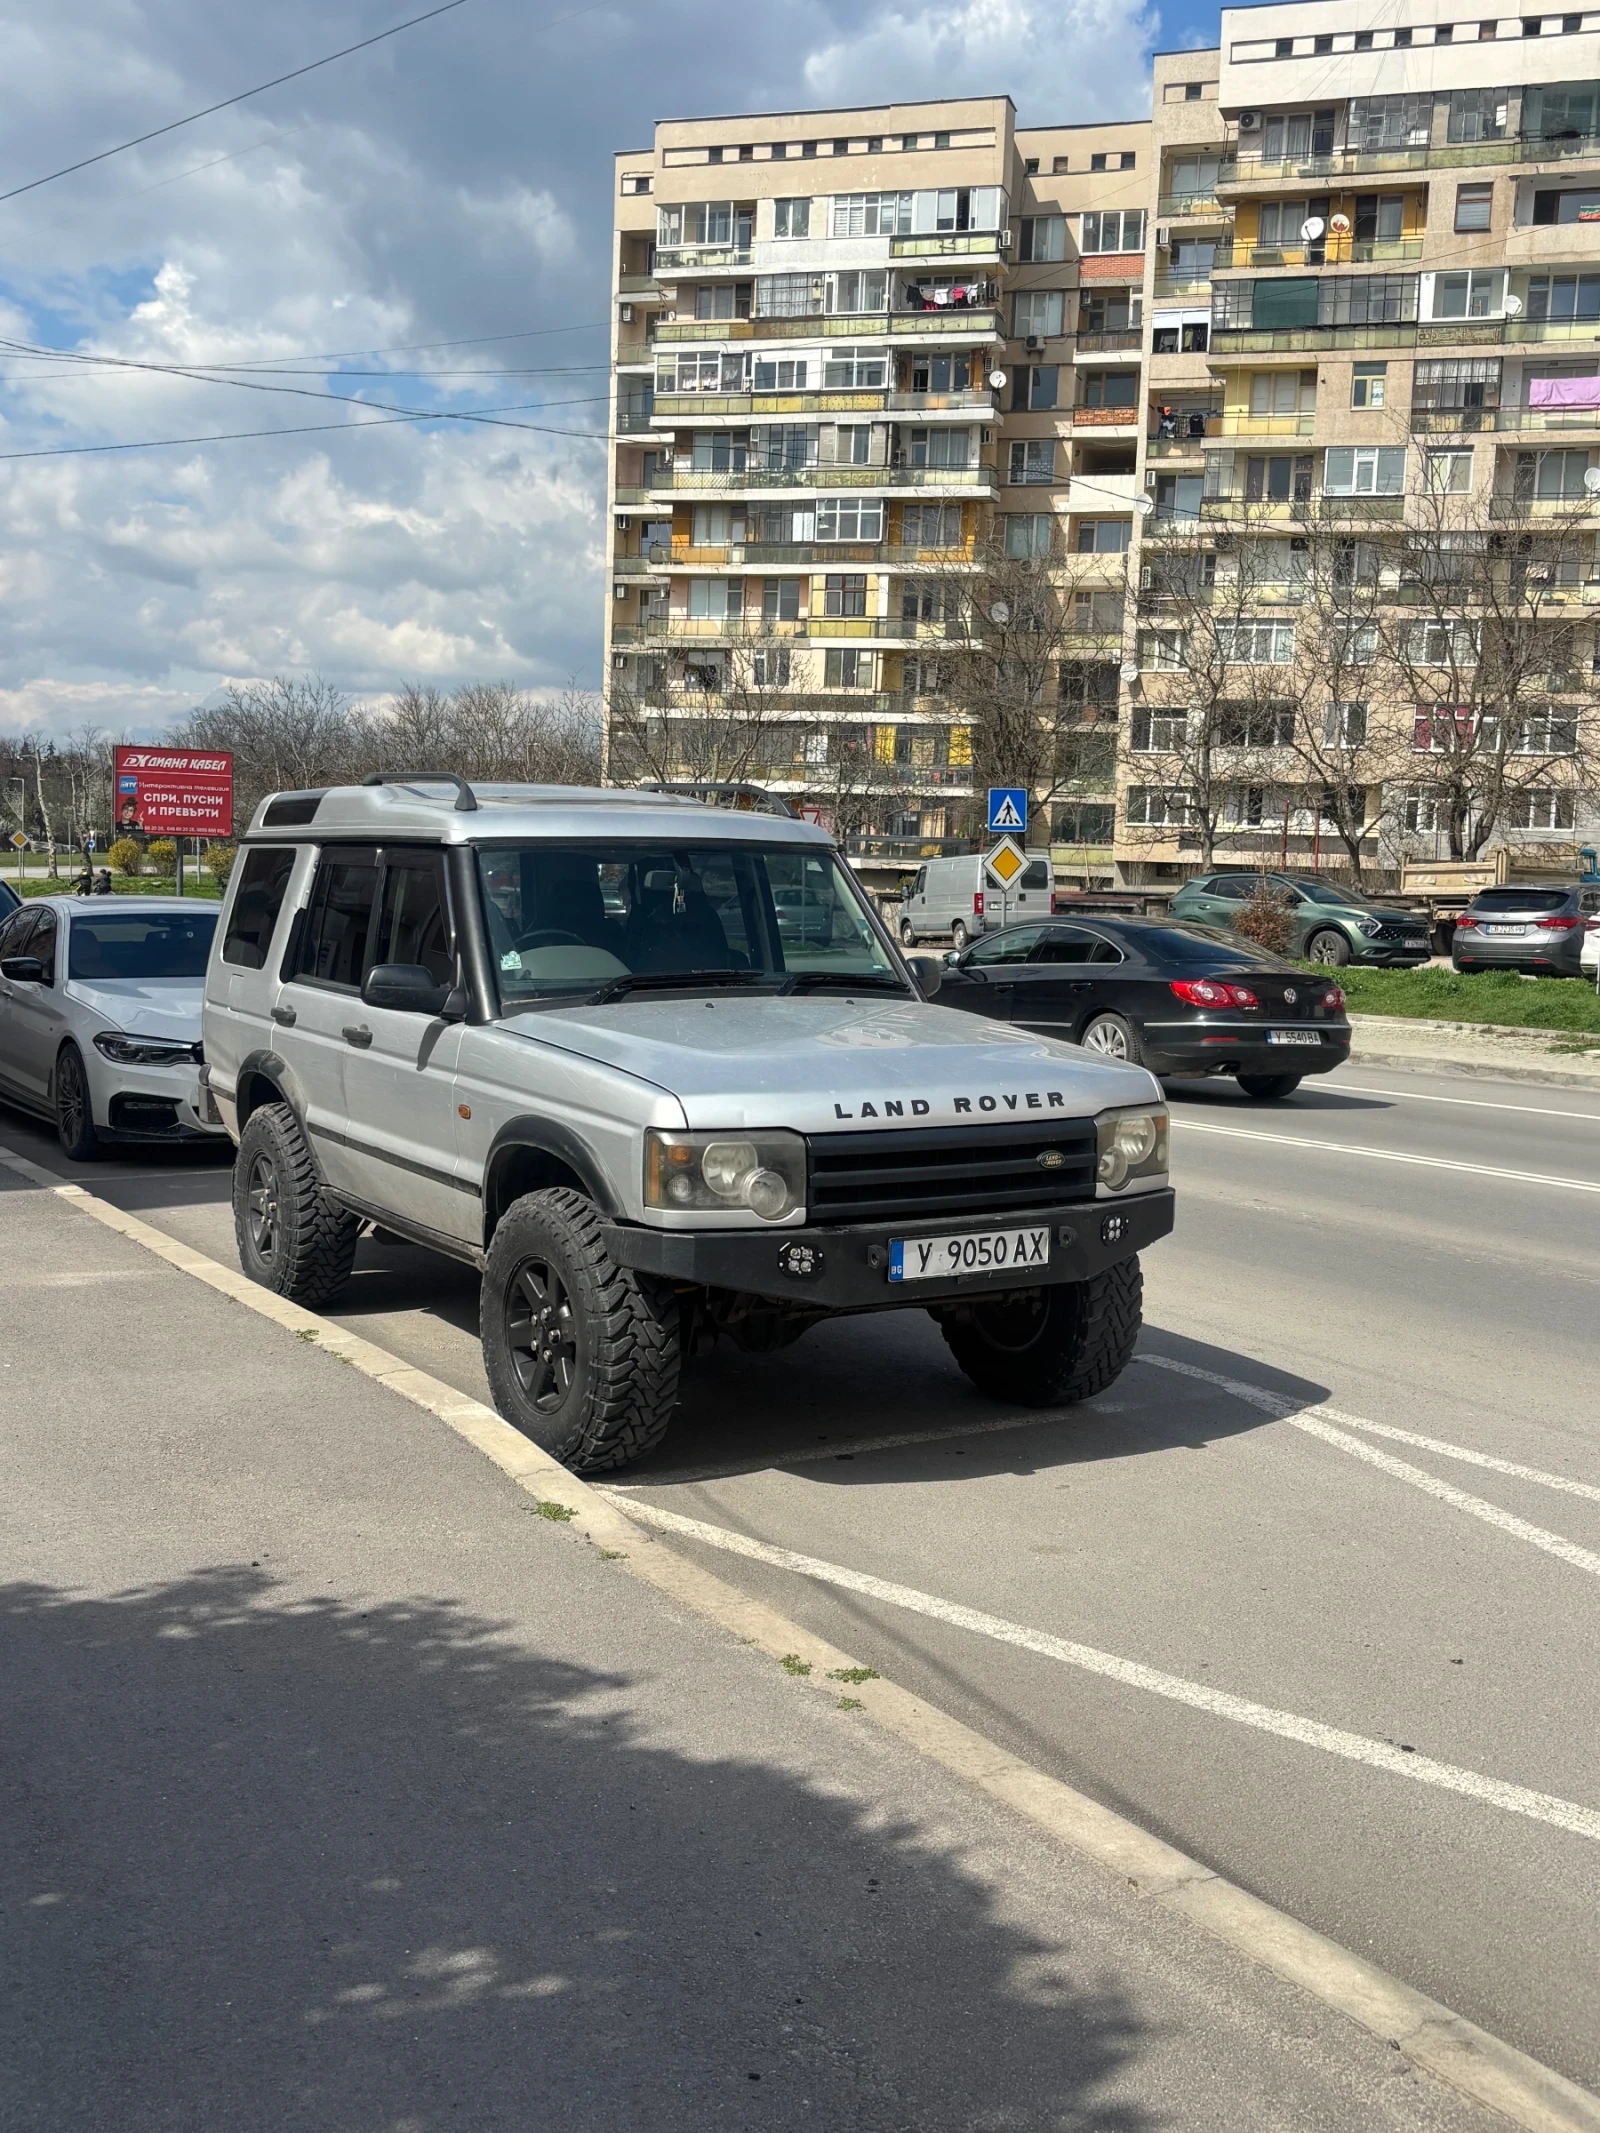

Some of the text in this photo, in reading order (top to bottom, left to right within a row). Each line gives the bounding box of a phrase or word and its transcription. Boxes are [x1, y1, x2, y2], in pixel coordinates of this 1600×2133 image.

[147, 756, 227, 771] ДИАНА КАБЕЛ
[138, 781, 193, 791] Интерактивна
[183, 794, 223, 805] ПУСНИ
[147, 806, 219, 818] И ПРЕВЪРТИ
[1285, 1032, 1307, 1043] 5540
[834, 1091, 1065, 1119] LAND ROVER
[947, 1235, 1008, 1270] 9050
[1013, 1231, 1044, 1263] AX
[891, 1265, 903, 1275] BG
